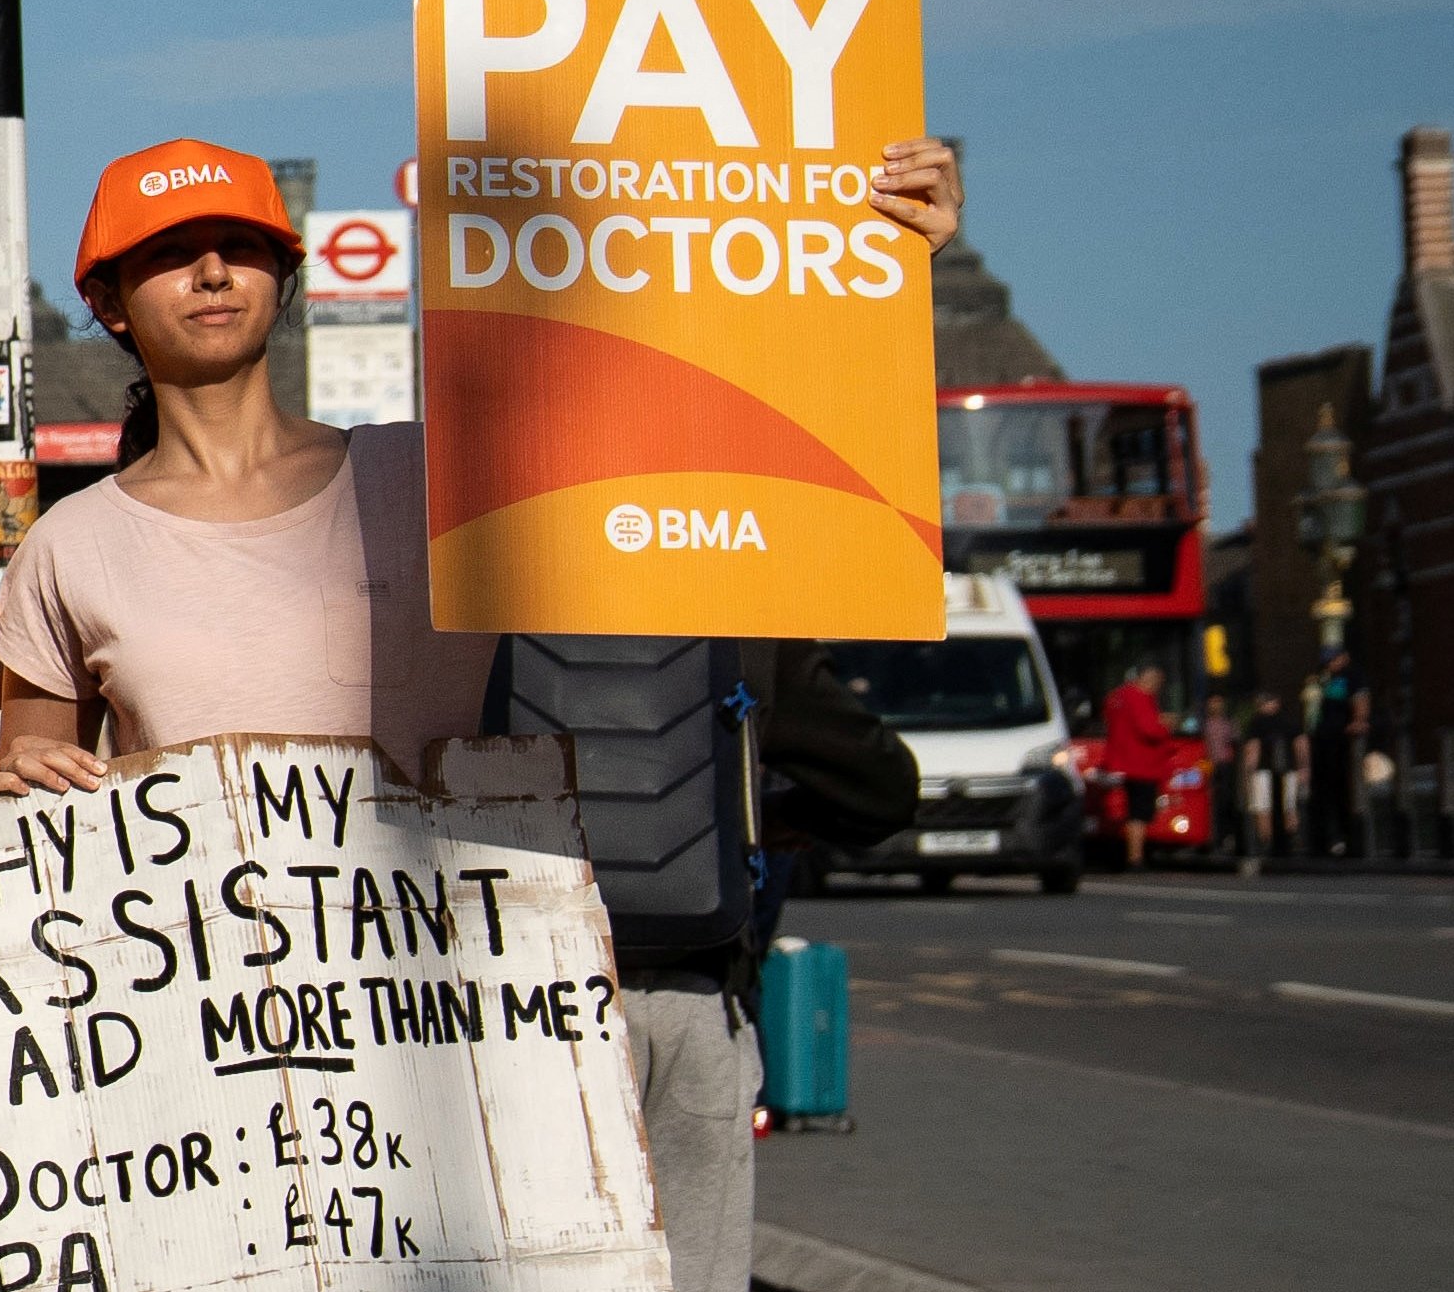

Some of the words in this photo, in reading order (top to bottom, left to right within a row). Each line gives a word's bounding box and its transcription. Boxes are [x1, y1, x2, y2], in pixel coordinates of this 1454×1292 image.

[170, 164, 232, 190] BMA
[447, 157, 789, 204] RESTORATION
[448, 214, 904, 299] DOCTORS
[658, 508, 767, 552] BMA
[111, 773, 191, 875] IS
[252, 762, 355, 848] MY
[201, 983, 355, 1063] MORE
[360, 975, 483, 1048] THAN
[503, 975, 615, 1045] ME?
